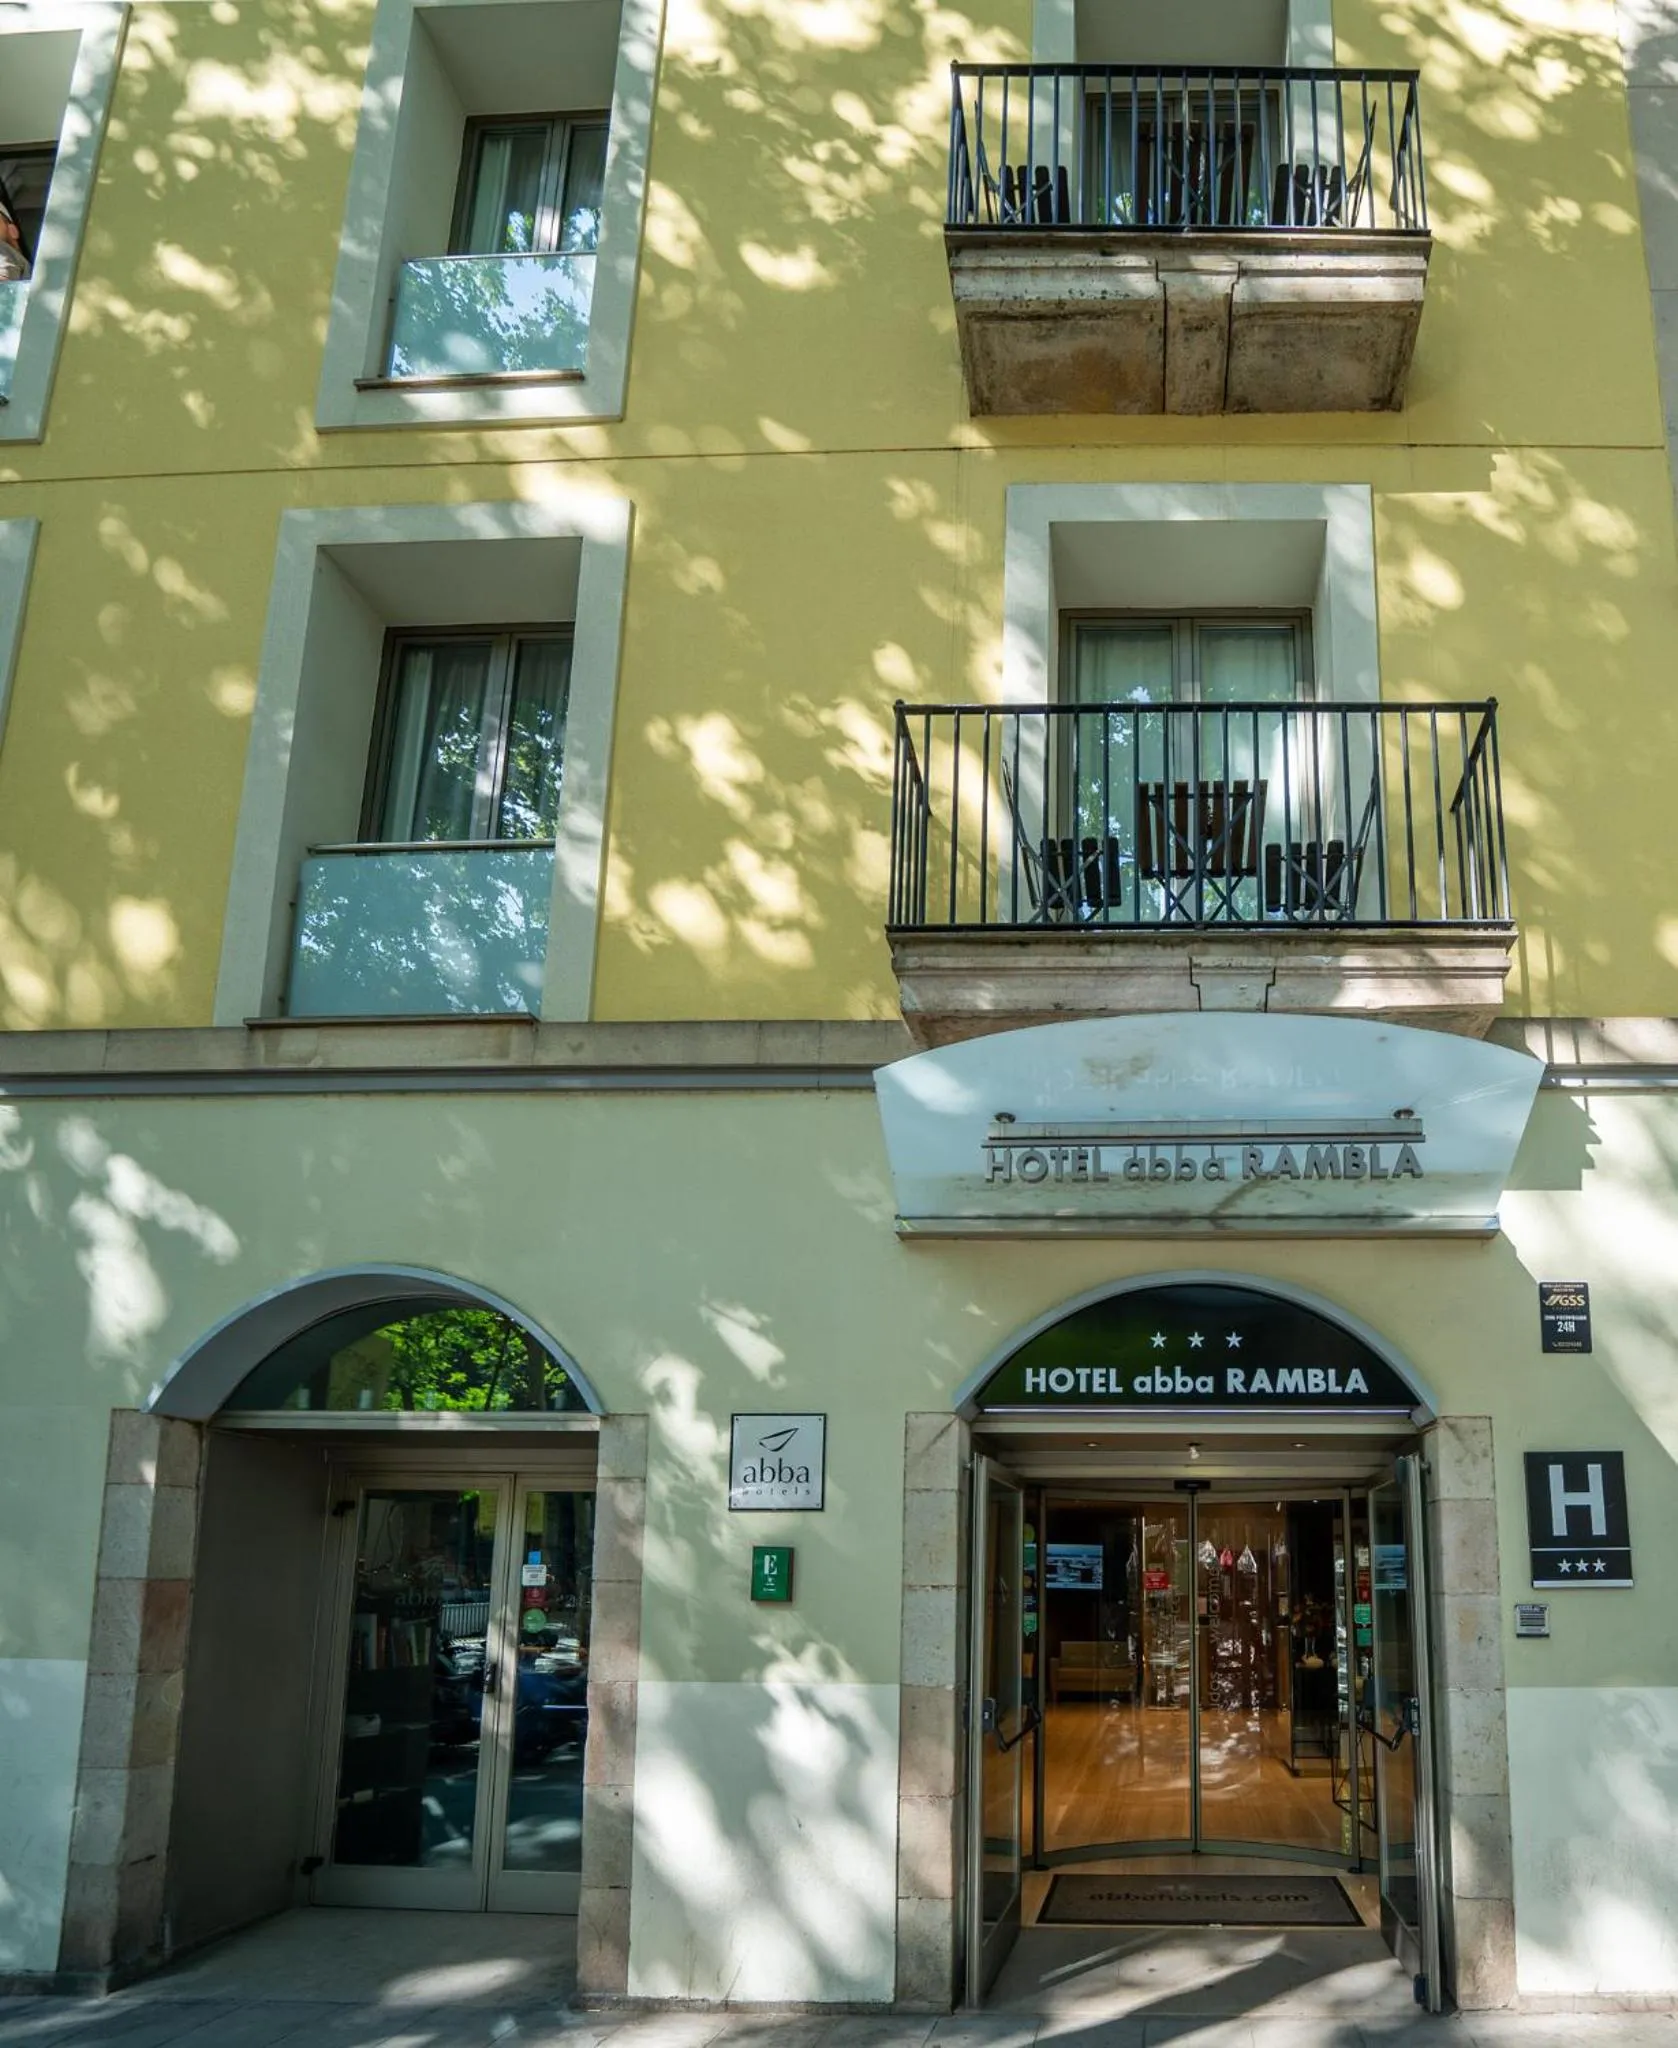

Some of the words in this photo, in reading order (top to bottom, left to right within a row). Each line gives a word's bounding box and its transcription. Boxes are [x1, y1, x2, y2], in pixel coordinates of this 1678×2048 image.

[982, 1146, 1109, 1182] HOTEL
[1123, 1145, 1230, 1181] abba
[1242, 1144, 1424, 1179] RAMBLA
[1558, 1294, 1586, 1306] GSS
[1557, 1321, 1575, 1332] 24H
[1025, 1367, 1122, 1394] HOTEL
[1133, 1365, 1214, 1394] abba
[1226, 1367, 1369, 1394] RAMBLA
[743, 1456, 810, 1484] abba
[1549, 1463, 1607, 1536] H
[1088, 1891, 1310, 1903] abbahotels.com
